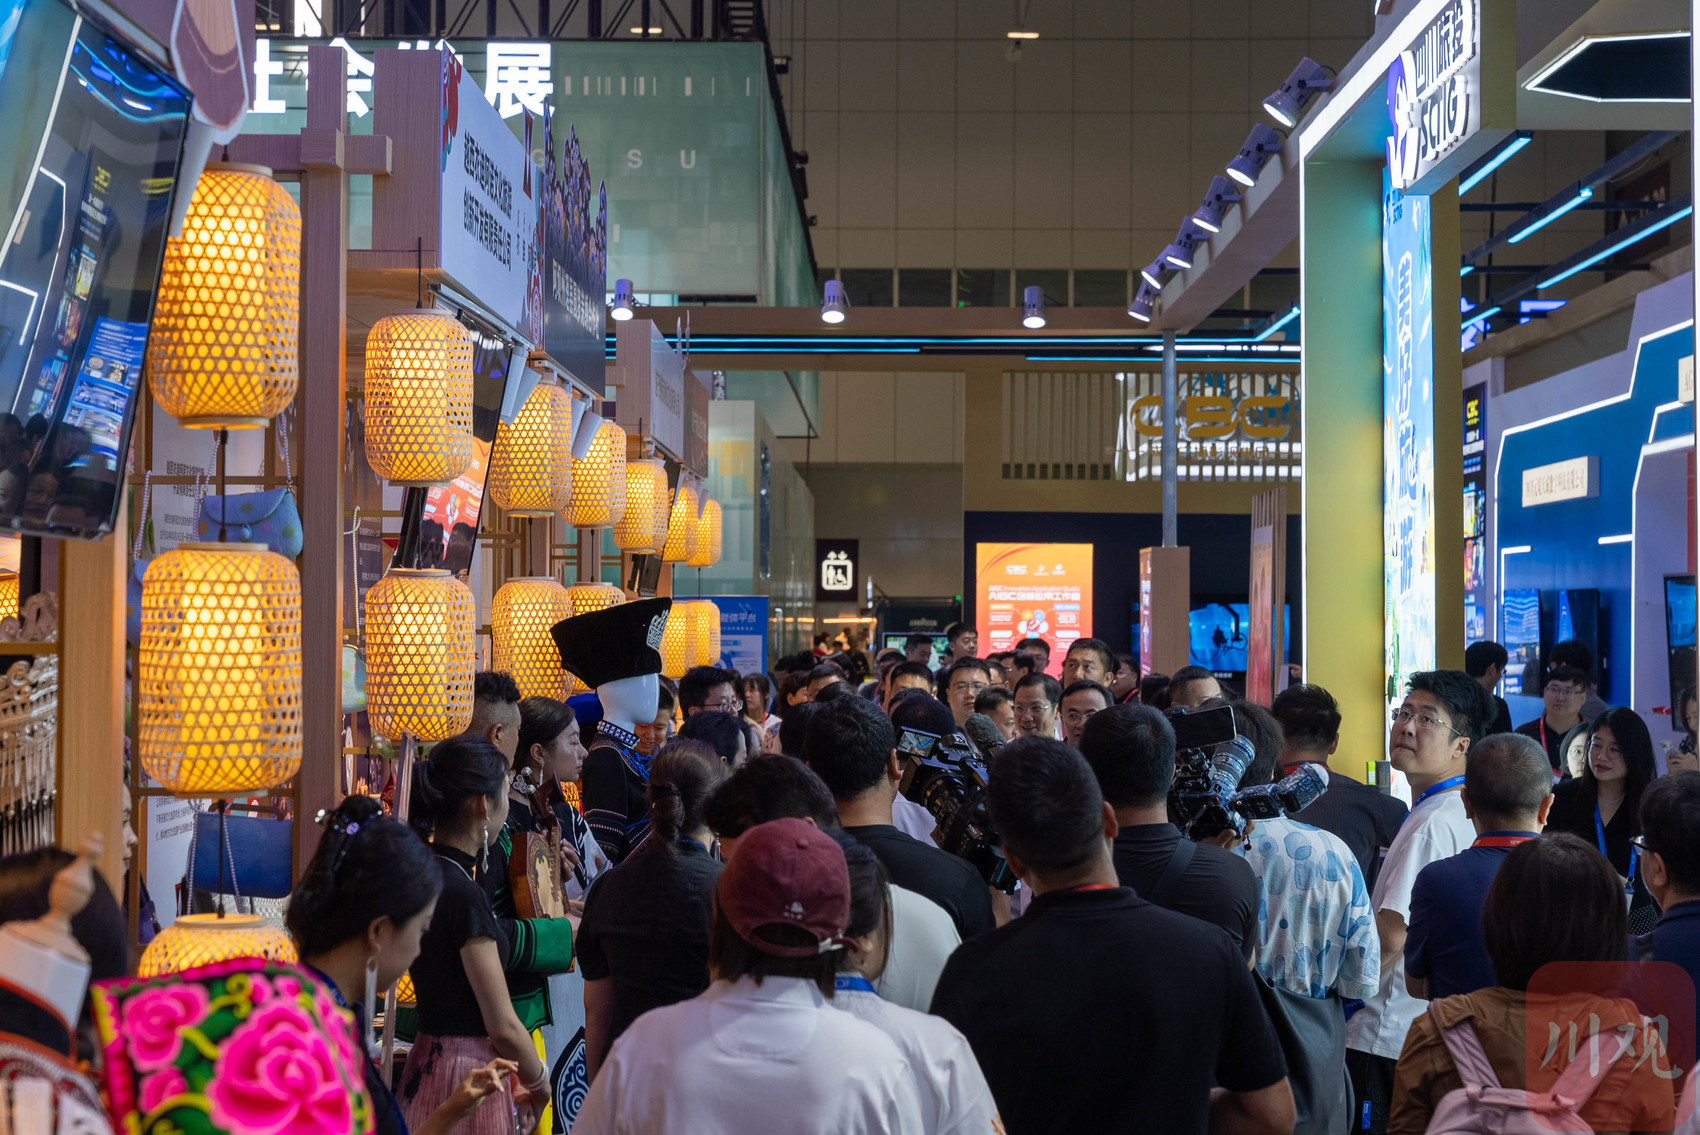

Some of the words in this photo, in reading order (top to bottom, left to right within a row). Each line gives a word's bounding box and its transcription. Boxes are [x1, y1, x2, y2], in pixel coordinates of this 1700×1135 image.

[464, 186, 512, 272] 创新开发有限责任公司
[1131, 396, 1289, 437] CBC
